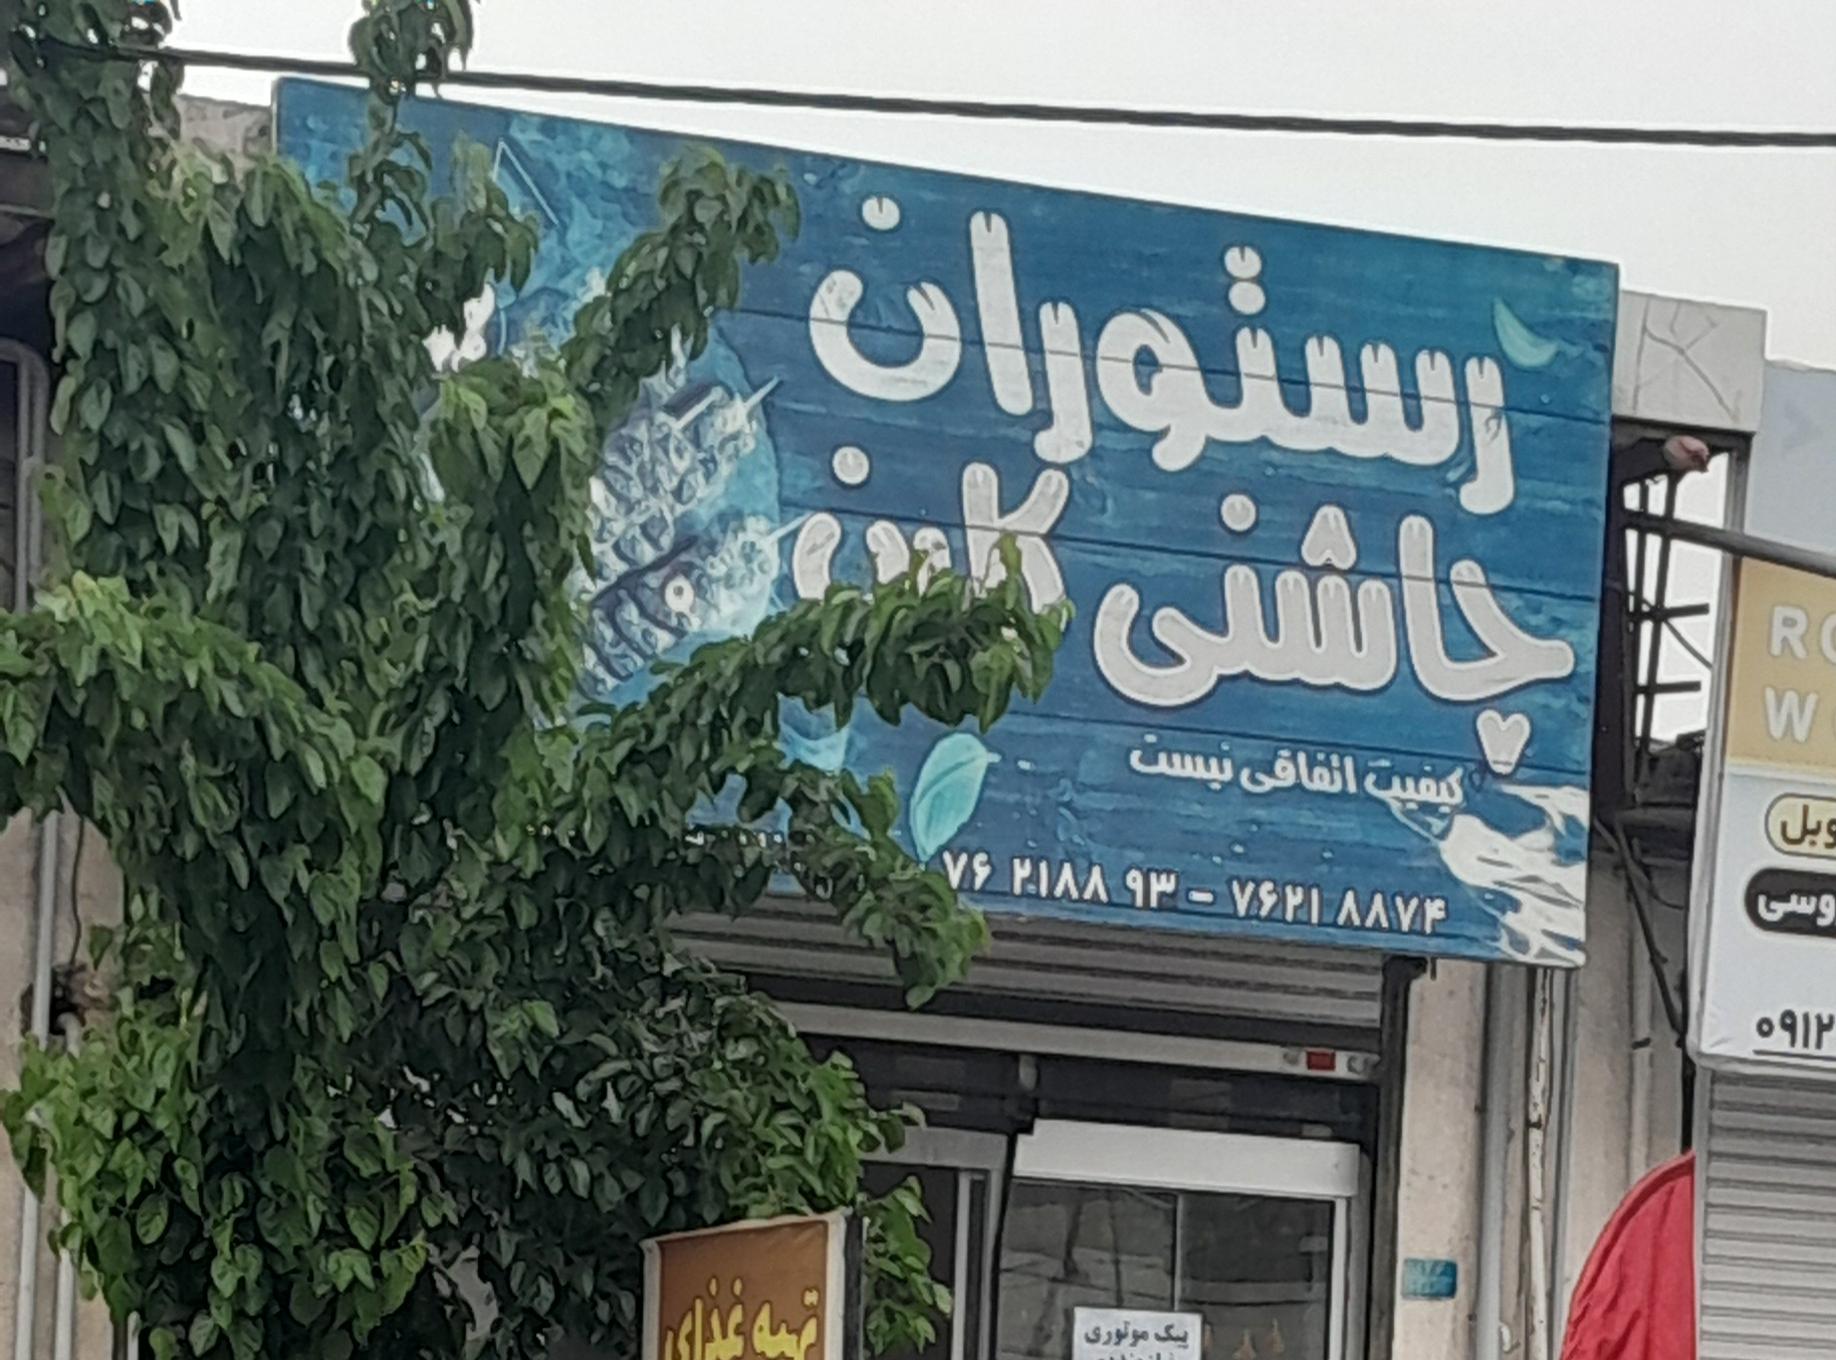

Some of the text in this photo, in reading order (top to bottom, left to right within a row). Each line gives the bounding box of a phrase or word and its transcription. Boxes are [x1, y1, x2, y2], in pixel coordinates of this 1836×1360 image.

[809, 194, 1516, 514] رستوران
[1094, 493, 1575, 775] چاشنی
[1129, 733, 1465, 813] کیفیت اتفاقی نیست
[1012, 856, 1110, 904] ۲۱۸۸
[1231, 878, 1322, 926] ۷۶۲۱
[1336, 889, 1449, 935] ۸۸۷۴
[1084, 1320, 1189, 1349] پیک موتوری
